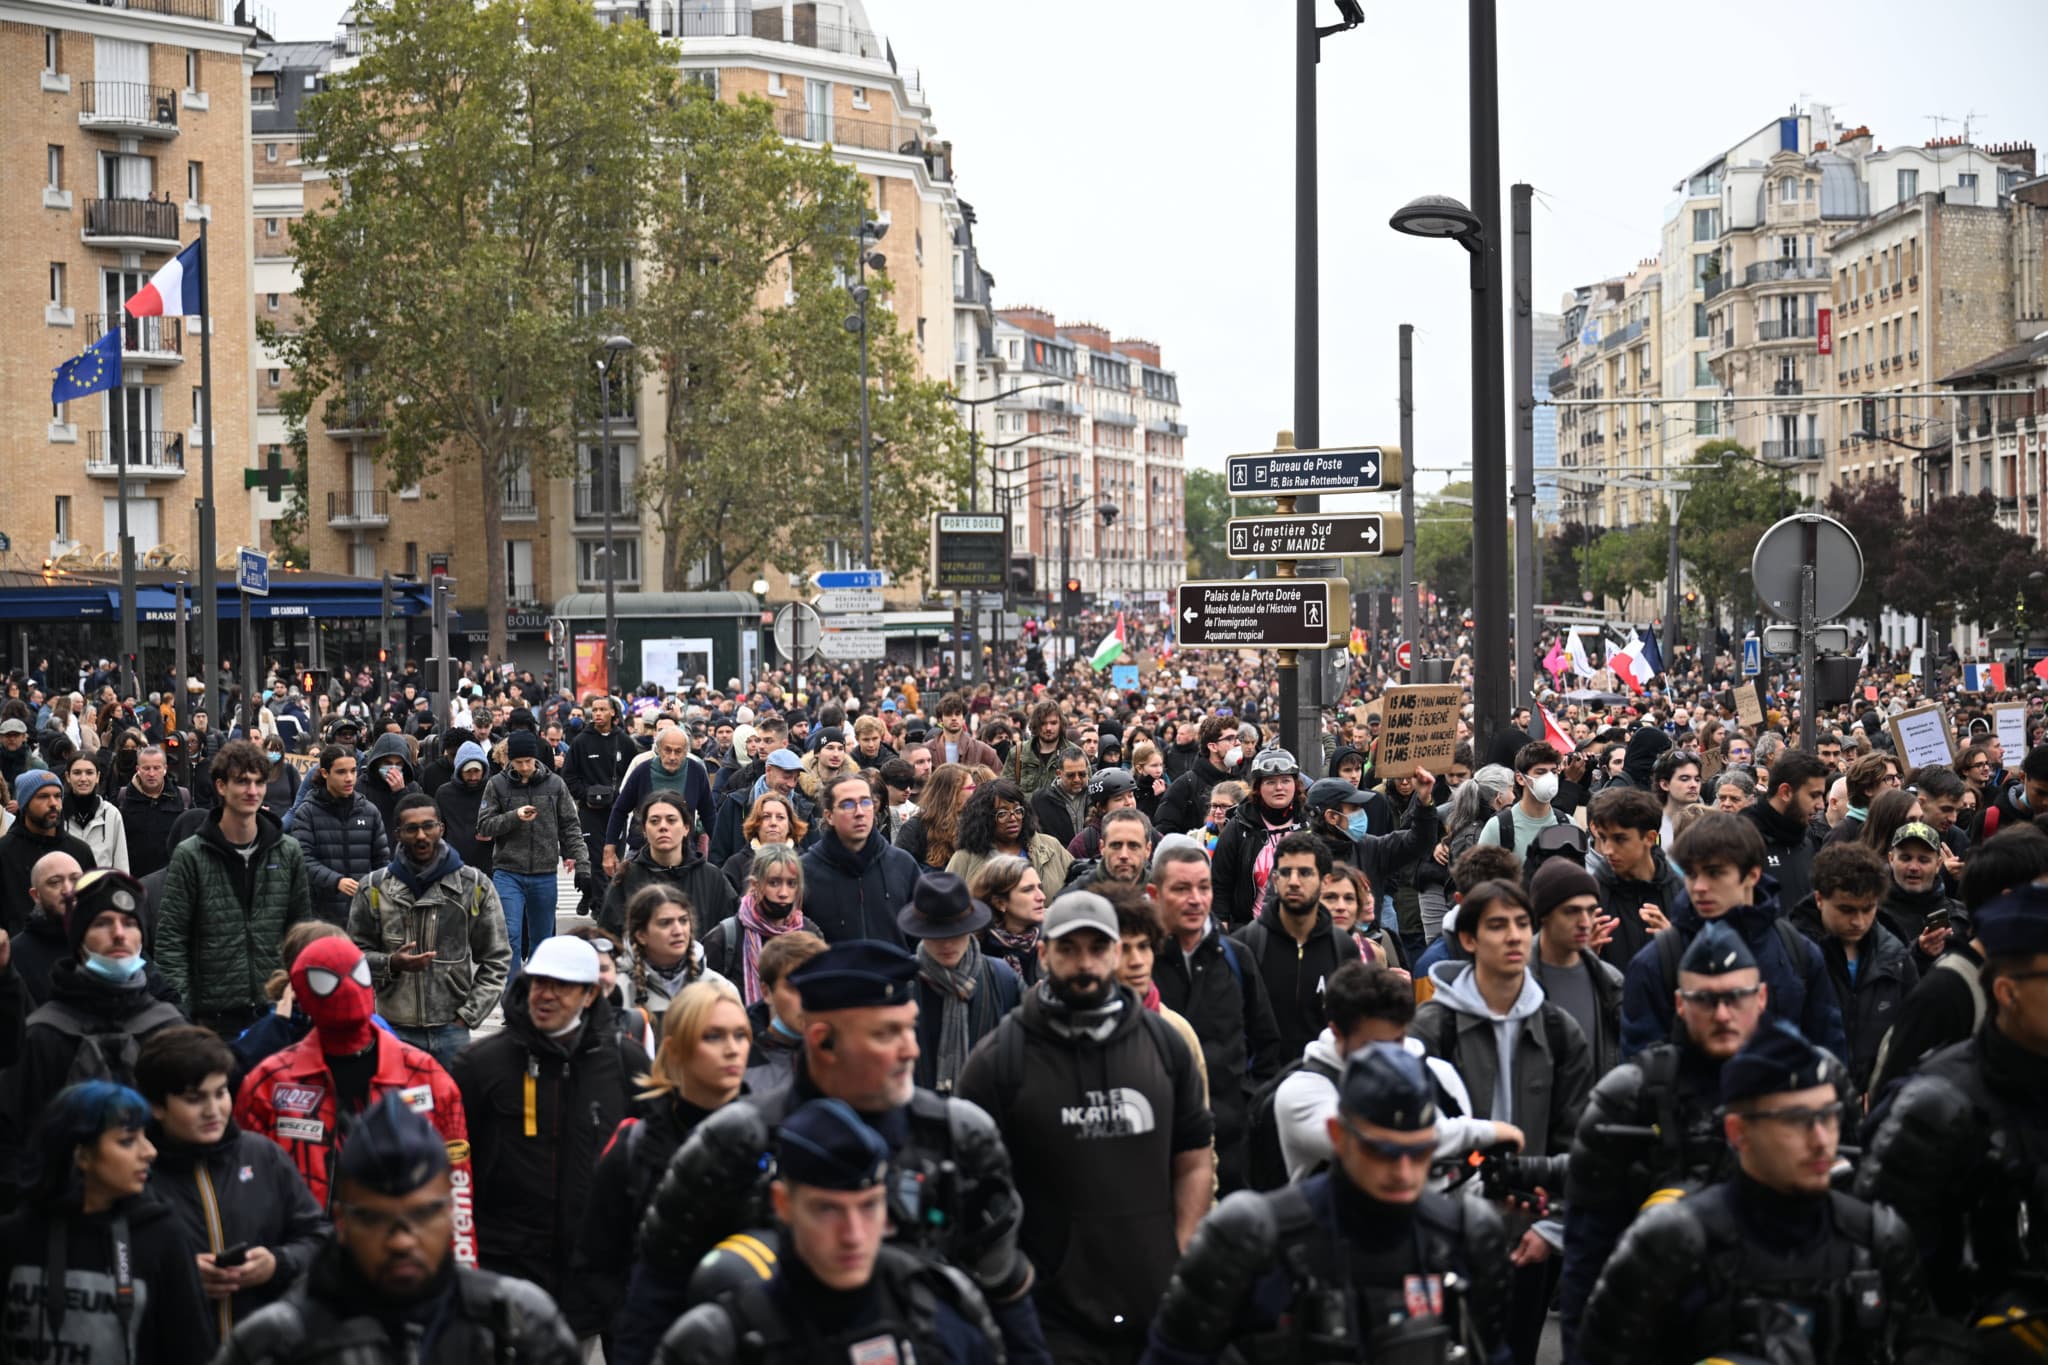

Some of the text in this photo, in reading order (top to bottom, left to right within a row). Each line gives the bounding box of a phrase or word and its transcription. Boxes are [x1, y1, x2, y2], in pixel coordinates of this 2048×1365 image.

[1270, 458, 1342, 473] Bureau de Poste
[1282, 477, 1293, 487] Bis
[1295, 476, 1309, 487] Rue
[1310, 475, 1359, 487] Rottembourg
[944, 518, 970, 529] PORTE
[1253, 523, 1333, 537] Cimetière Sud
[1253, 539, 1265, 552] de
[1286, 535, 1326, 551] MANDÉ
[1204, 588, 1301, 602] Palais de la Porte Dorée
[146, 611, 190, 620] BRASSE
[1204, 603, 1297, 614] Musée National de l'Histoire
[1204, 617, 1258, 629] de l'Immigration
[1204, 630, 1264, 642] Aquarium tropical
[1390, 695, 1398, 709] 15
[1388, 714, 1397, 728] 16
[1385, 732, 1394, 747] 17
[1384, 749, 1393, 764] 17
[1085, 1089, 1122, 1106] THE
[1061, 1104, 1123, 1124] NORTH
[449, 1169, 477, 1263] preme
[117, 1240, 130, 1285] SONY
[8, 1282, 116, 1314] MUEU
